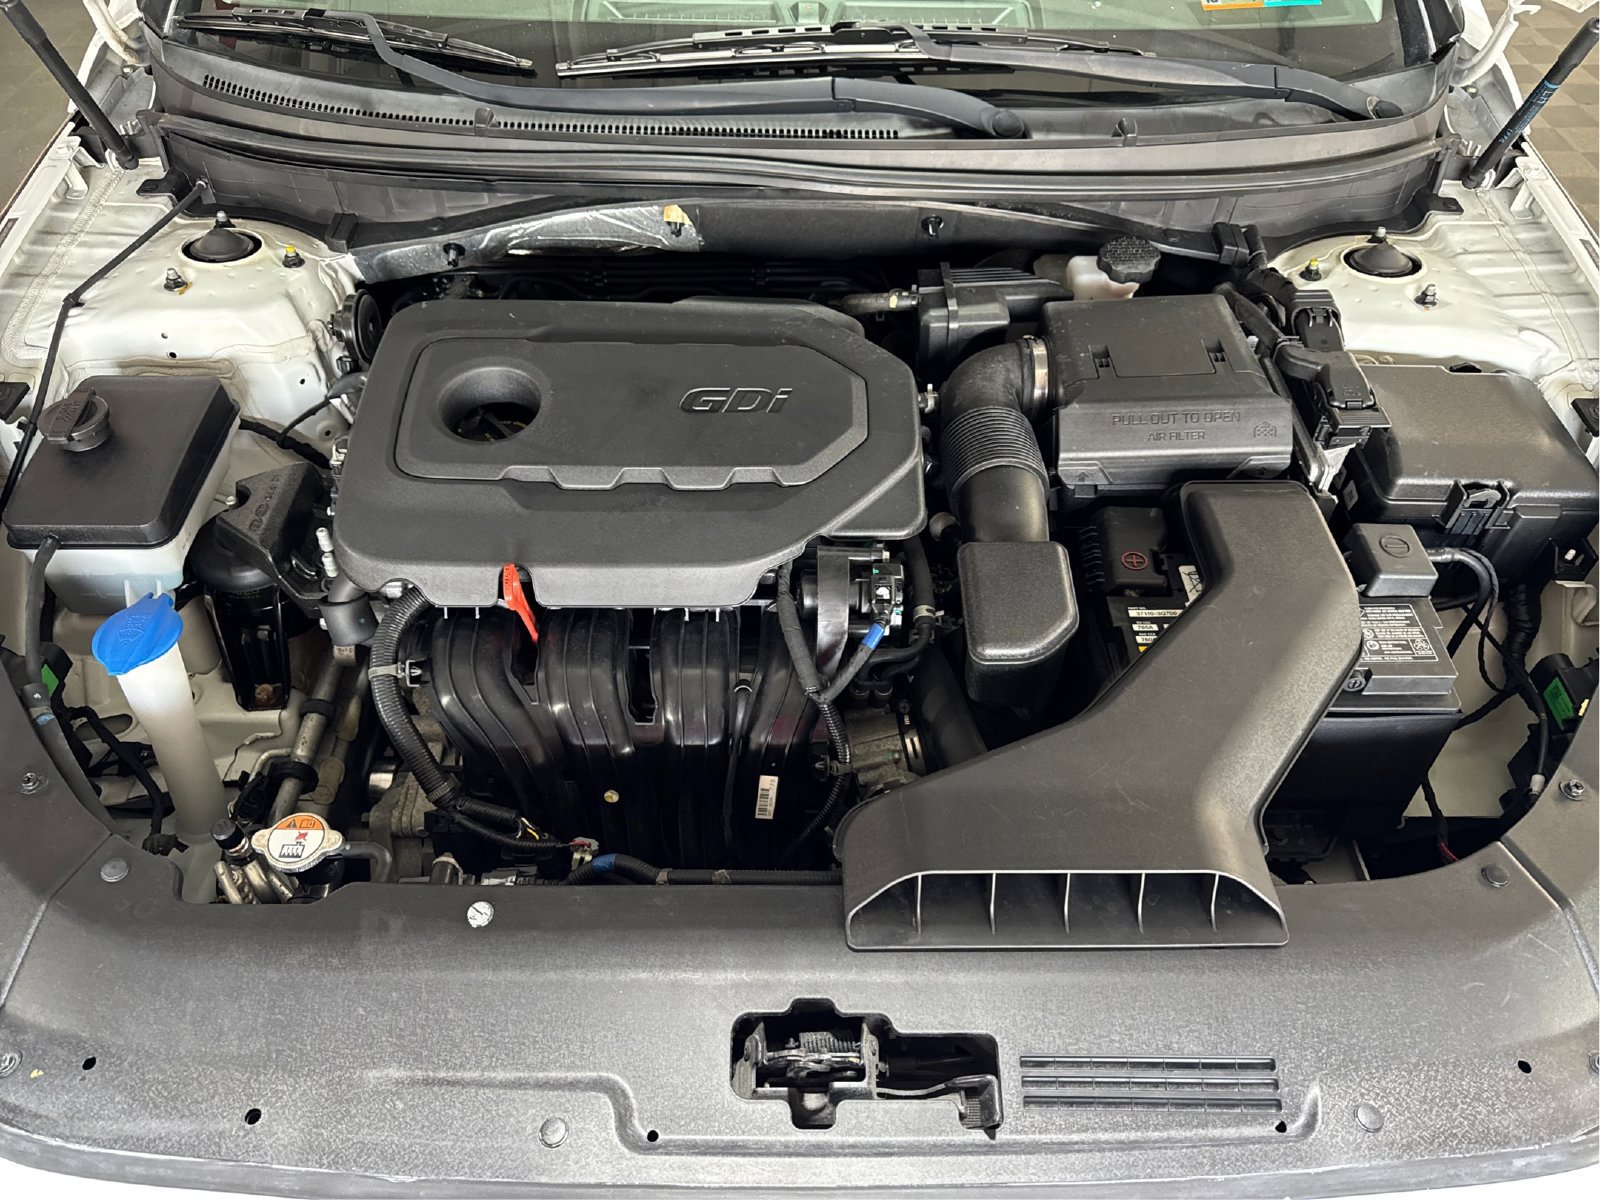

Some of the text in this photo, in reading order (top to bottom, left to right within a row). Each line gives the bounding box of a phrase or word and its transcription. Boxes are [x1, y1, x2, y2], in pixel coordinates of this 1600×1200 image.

[679, 387, 793, 413] GDi
[1112, 410, 1241, 426] PULL OUT TO OPEN
[1147, 430, 1206, 442] AIR FILTER
